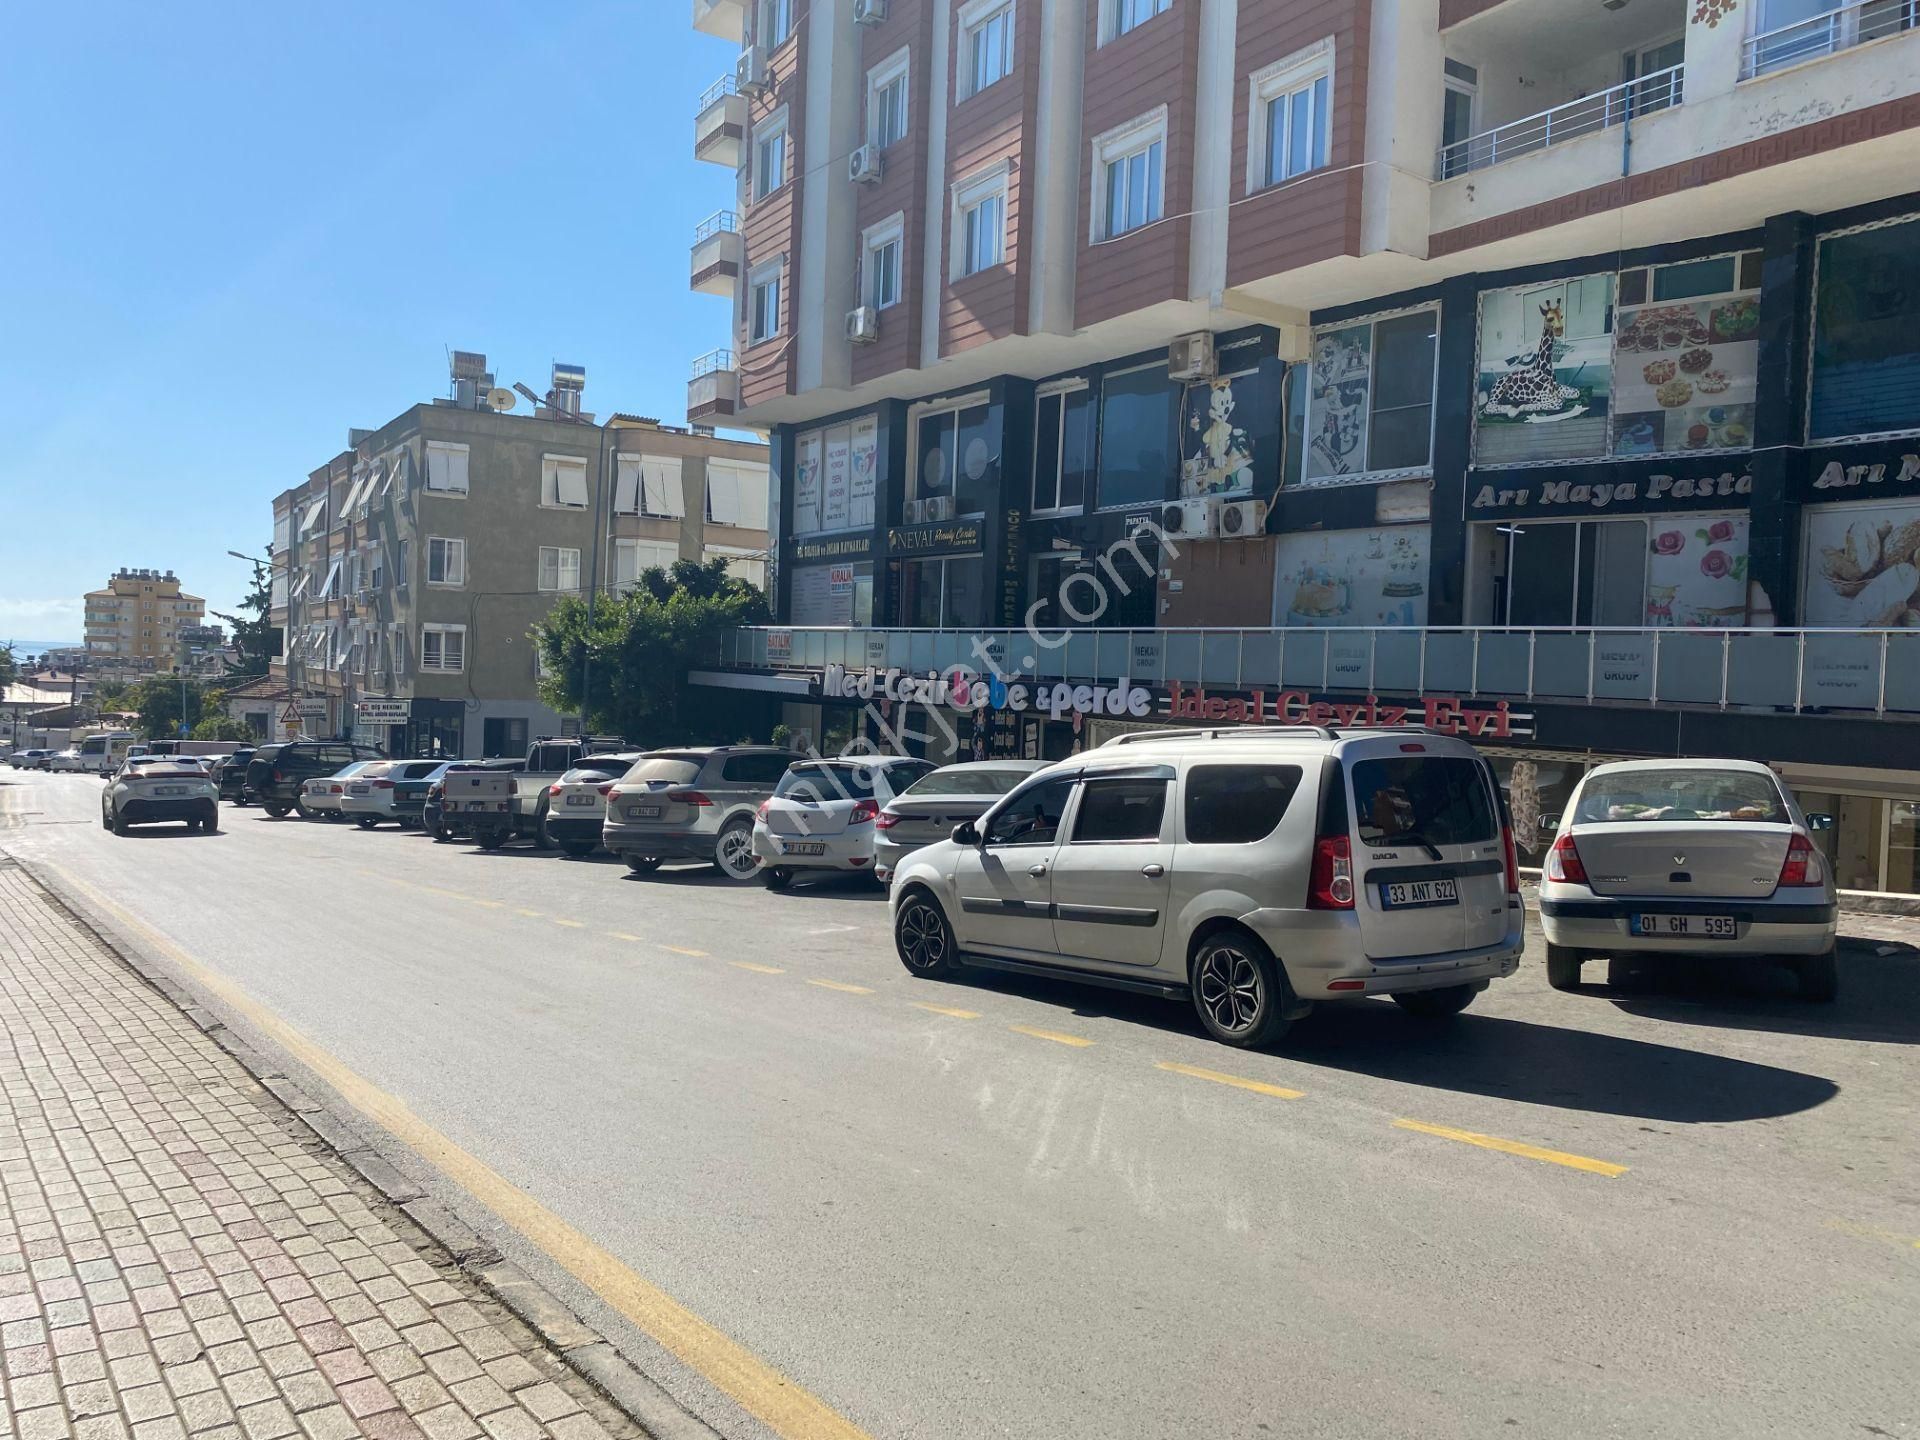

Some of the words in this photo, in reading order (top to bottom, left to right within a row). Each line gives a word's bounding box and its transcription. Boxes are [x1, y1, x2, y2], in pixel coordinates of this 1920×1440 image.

[1538, 481, 1637, 507] Maya
[898, 530, 935, 549] NEVAL
[1135, 646, 1159, 656] MEKAN
[1036, 686, 1051, 711] &
[1051, 677, 1152, 721] perde
[1420, 696, 1513, 737] Evi
[1390, 885, 1406, 902] 33
[1411, 883, 1431, 900] ANT
[1435, 881, 1455, 898] 622
[1642, 916, 1657, 931] 01
[1670, 917, 1688, 932] GH
[1705, 918, 1732, 934] 595
